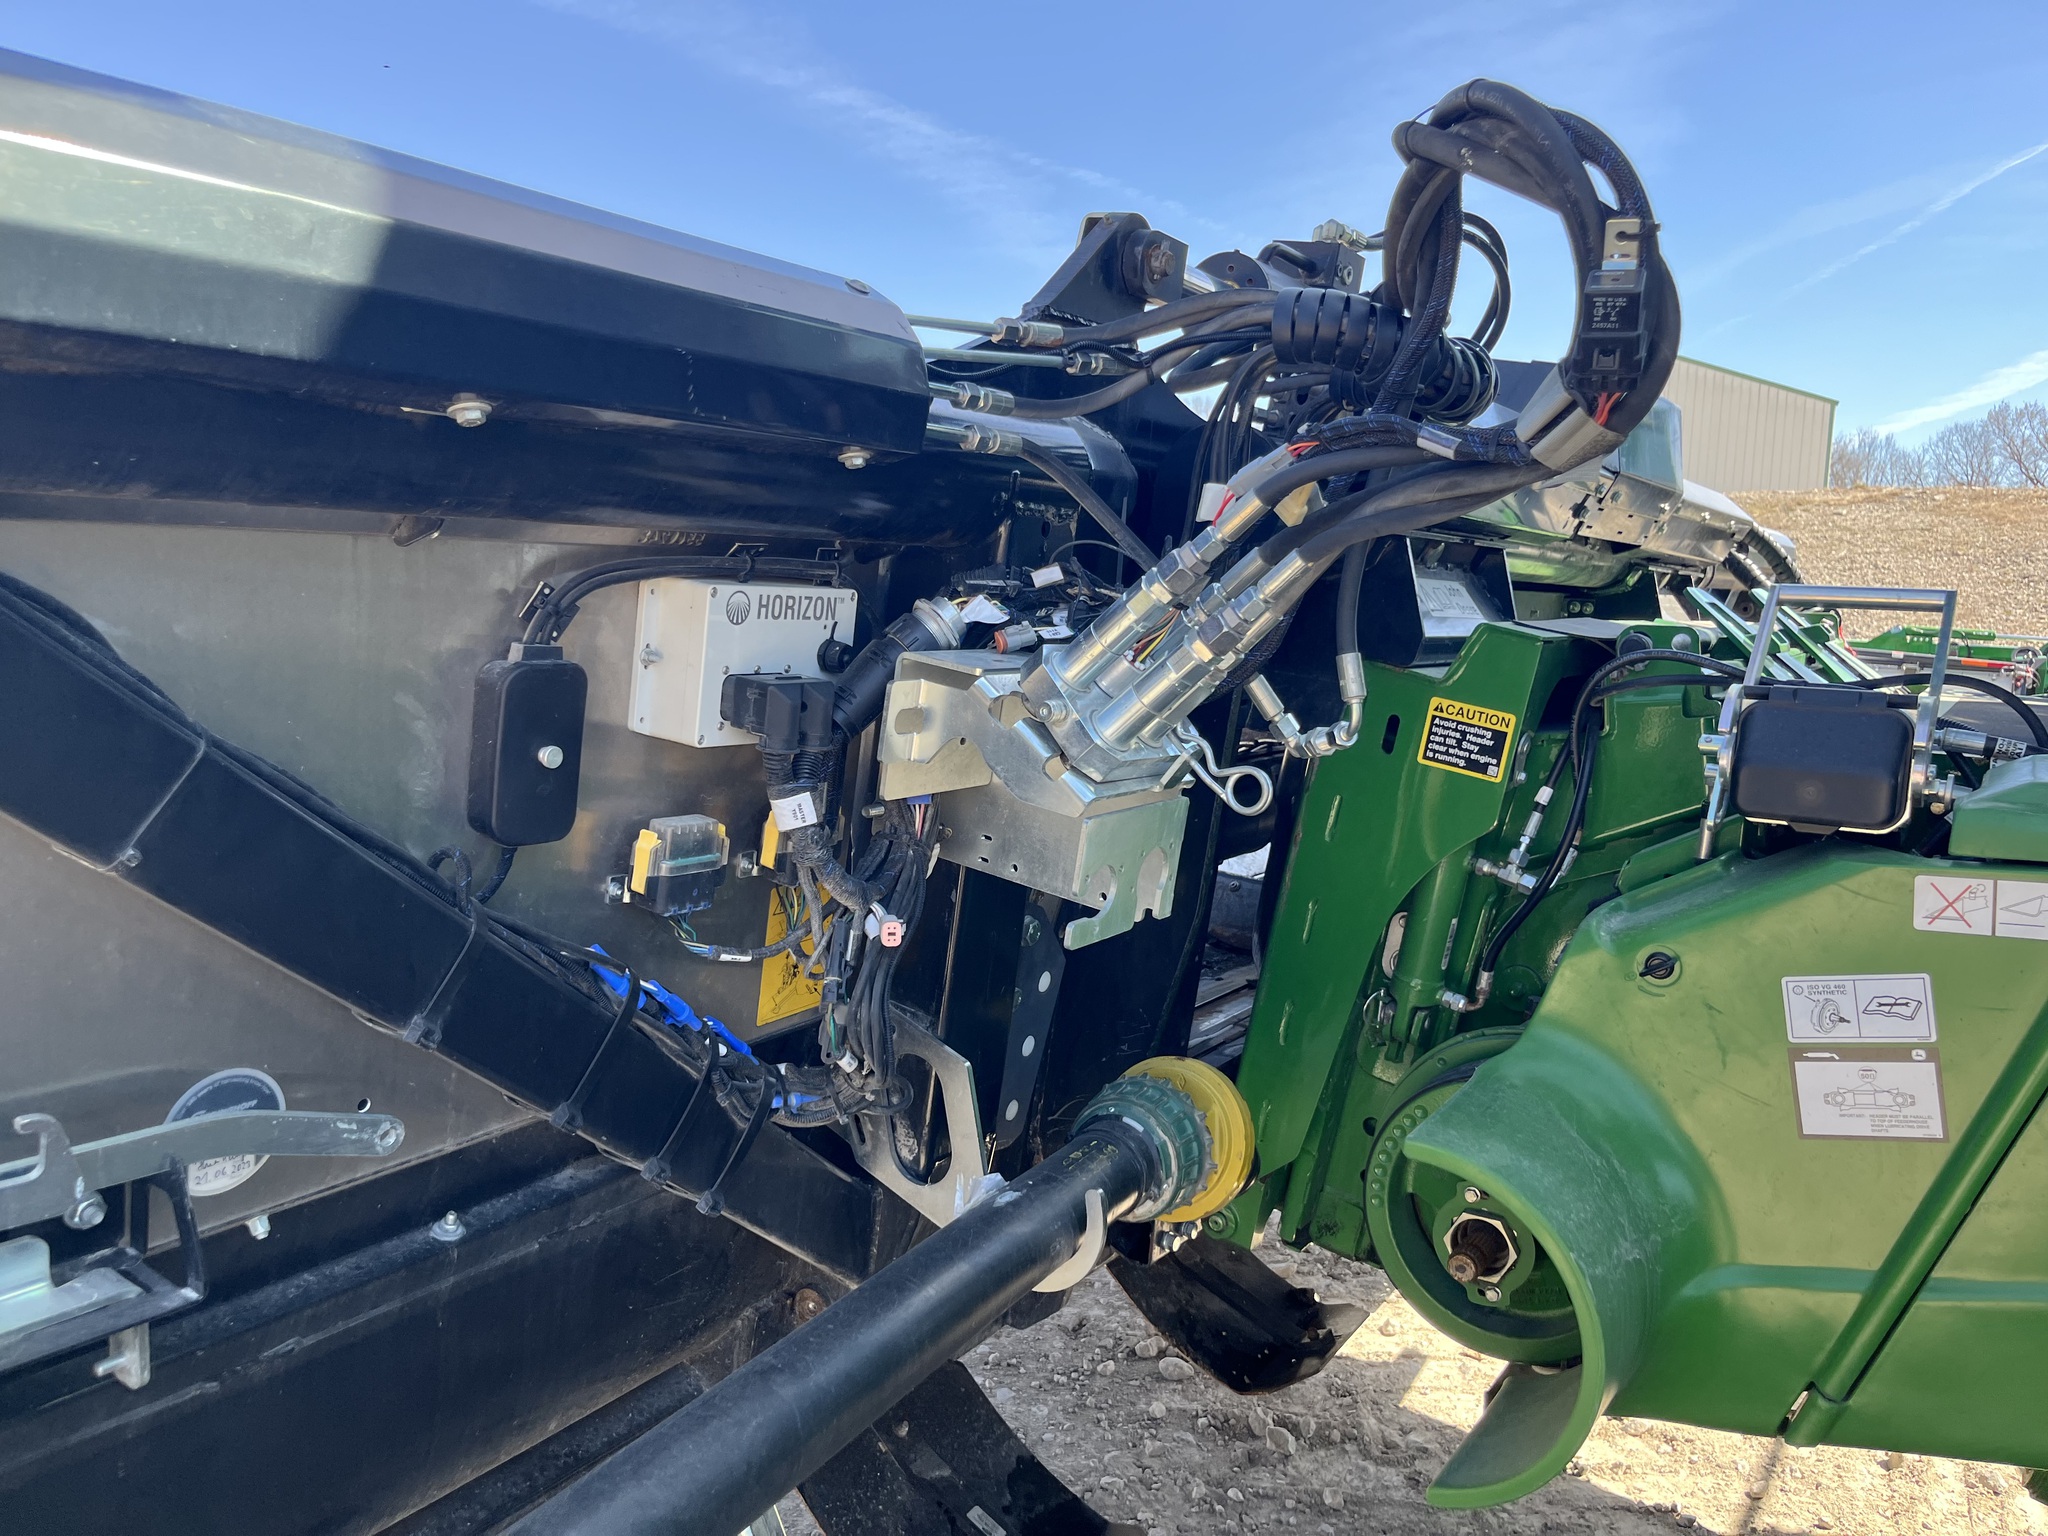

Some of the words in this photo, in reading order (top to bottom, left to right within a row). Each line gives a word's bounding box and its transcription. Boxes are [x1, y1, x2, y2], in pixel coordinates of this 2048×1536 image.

[757, 594, 838, 621] HORIZON
[1445, 704, 1511, 729] CAUTION
[1431, 726, 1462, 739] injuries.
[1466, 733, 1495, 747] Header
[1433, 717, 1457, 729] Avoid
[1457, 724, 1492, 739] crushing
[1428, 742, 1448, 752] clear
[1448, 747, 1470, 758] when
[1470, 753, 1498, 765] engine
[1429, 734, 1444, 743] can
[1445, 737, 1458, 747] tilt.
[1461, 741, 1480, 753] Stay
[1426, 749, 1434, 758] is
[1434, 752, 1467, 767] running.
